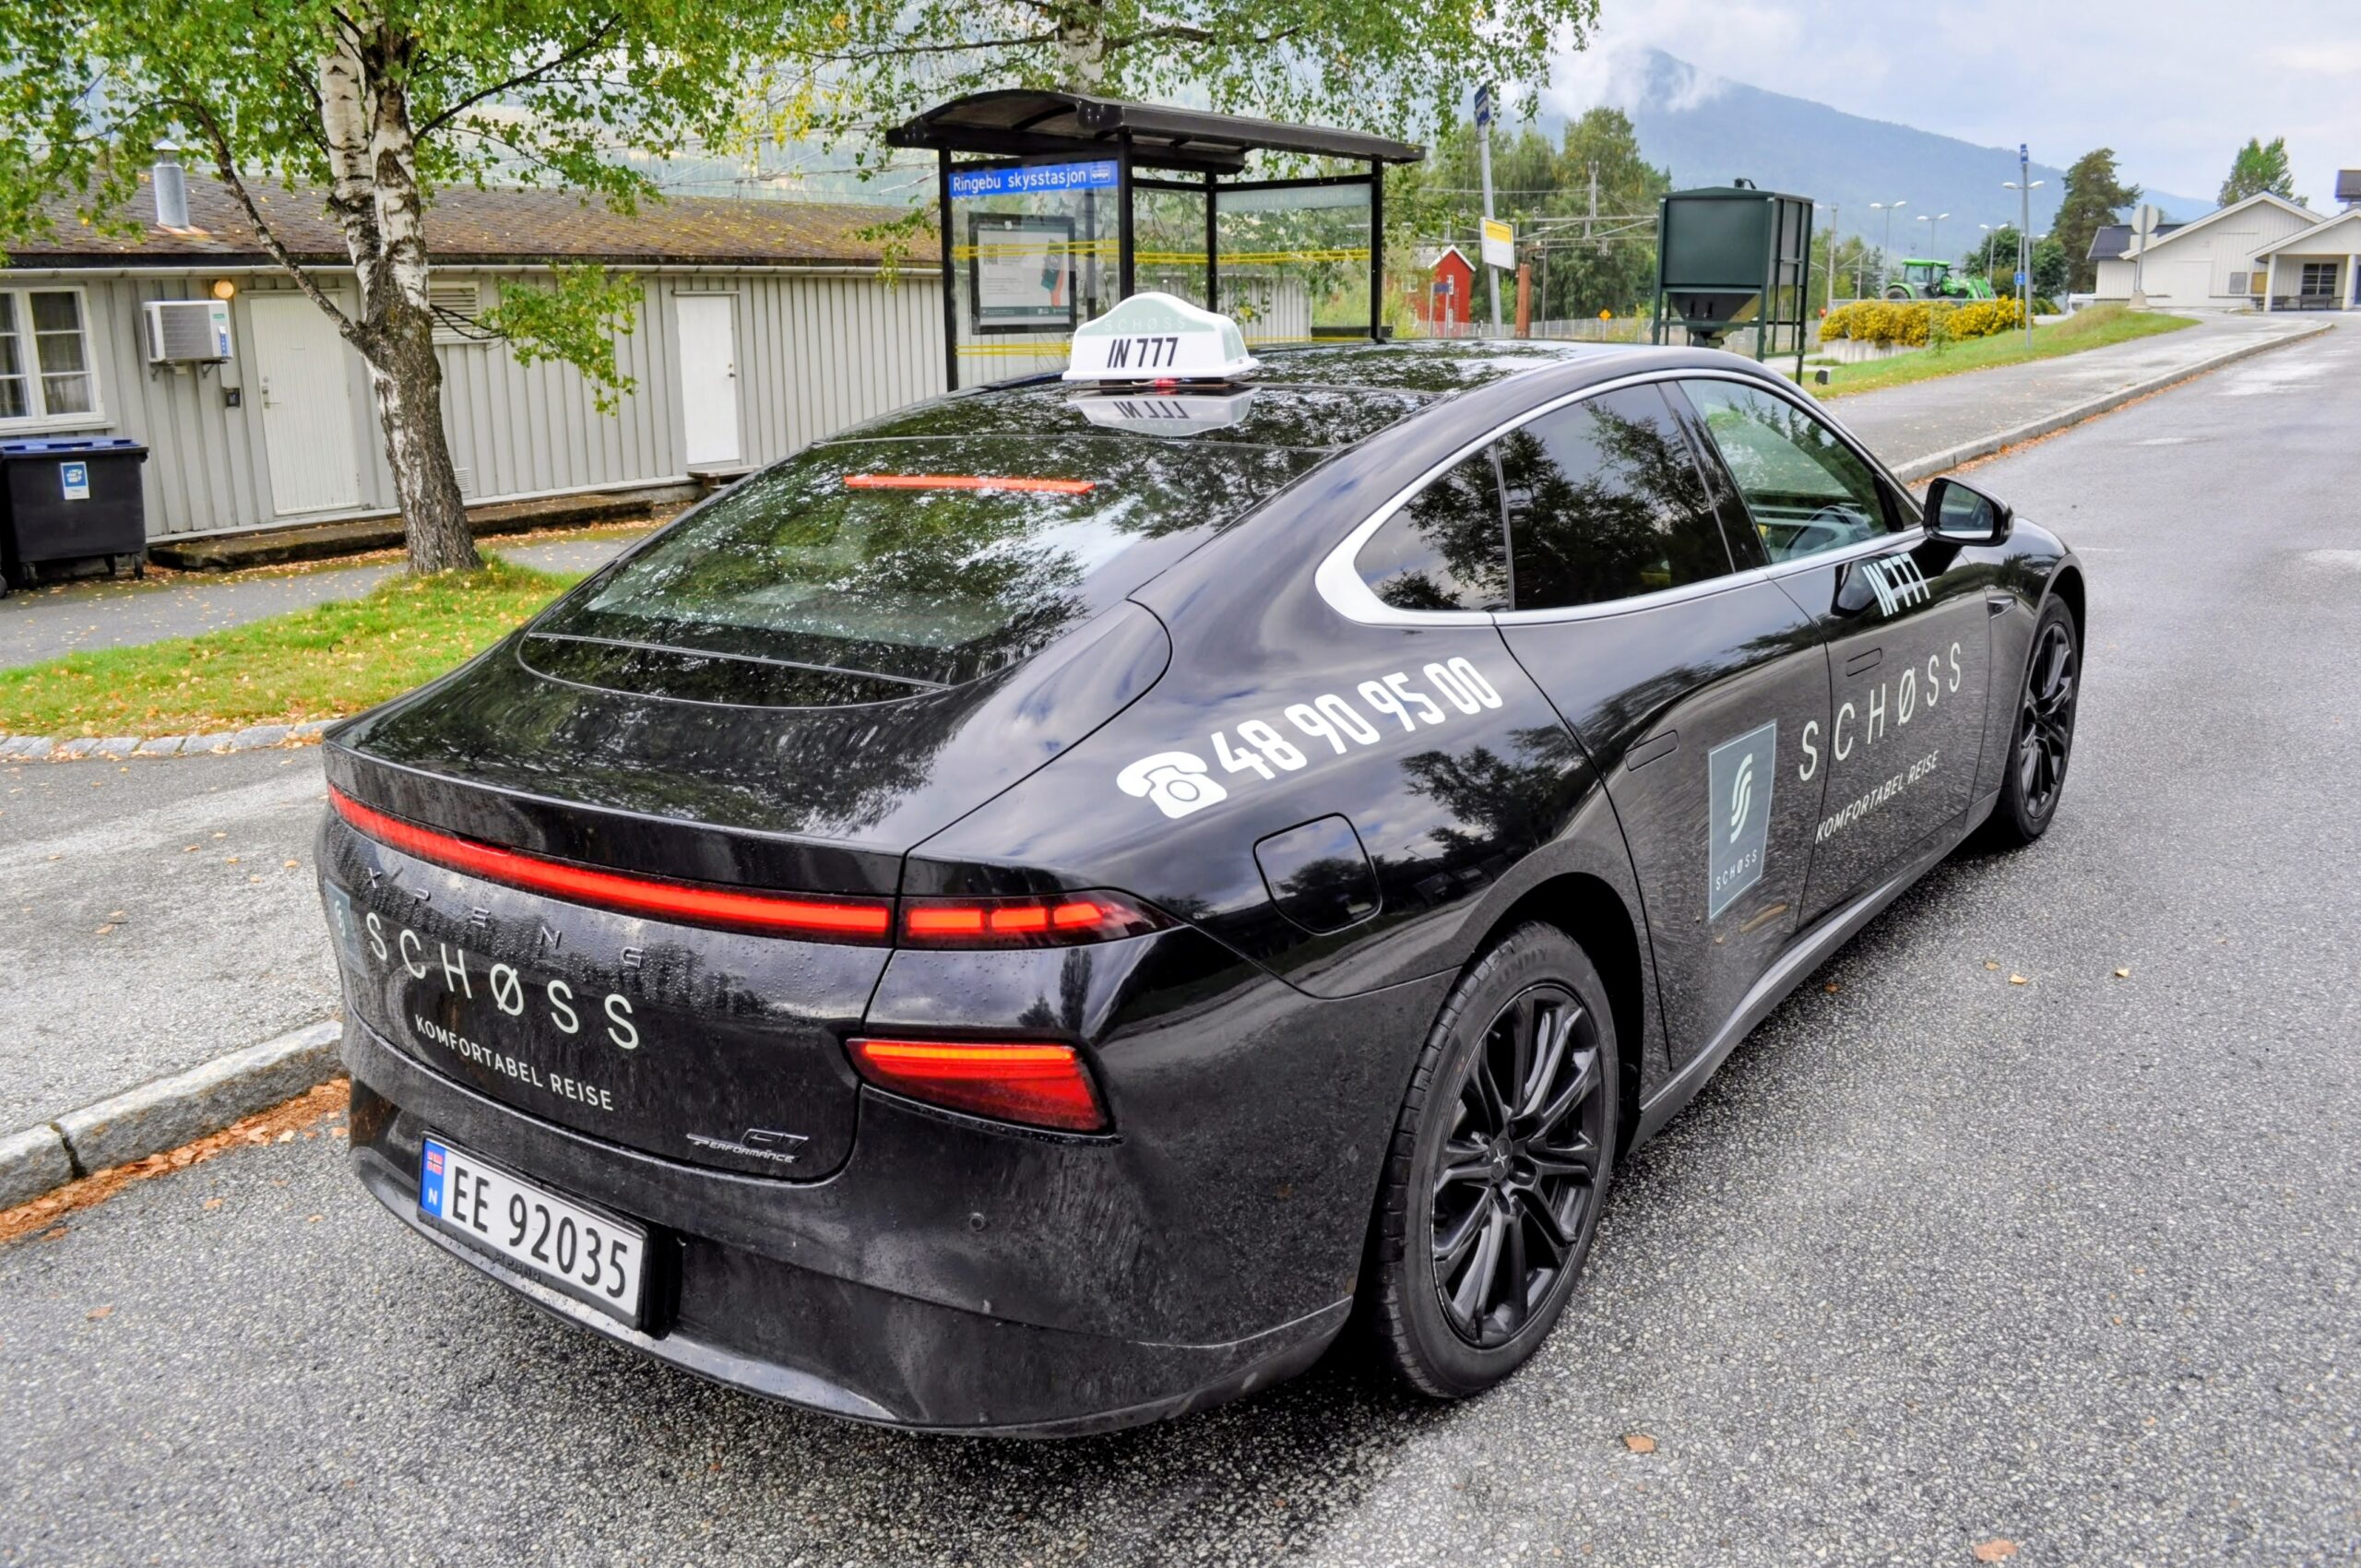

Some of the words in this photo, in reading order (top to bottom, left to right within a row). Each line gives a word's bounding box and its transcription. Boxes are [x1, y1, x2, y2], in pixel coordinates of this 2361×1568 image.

[953, 172, 1001, 194] Ringebu
[1007, 168, 1086, 191] skysstasjon
[1107, 339, 1131, 368] IN
[1136, 337, 1179, 367] 777
[1861, 563, 1899, 617] IN
[1880, 552, 1930, 607] 777
[1211, 719, 1308, 780] 48
[1284, 694, 1381, 754] 90
[1358, 671, 1446, 732] 95
[1423, 657, 1503, 715] 00
[1798, 642, 1962, 781] SCHØSS
[1815, 772, 1903, 844] KOMFORTABEL
[1908, 750, 1939, 785] REISE
[1716, 849, 1757, 891] SCHØSS
[366, 912, 639, 1050] SCHØSS
[415, 1015, 542, 1087] KOMFORTABEL
[550, 1073, 613, 1111] REISE
[452, 1165, 489, 1233] EE
[509, 1194, 627, 1298] 92035
